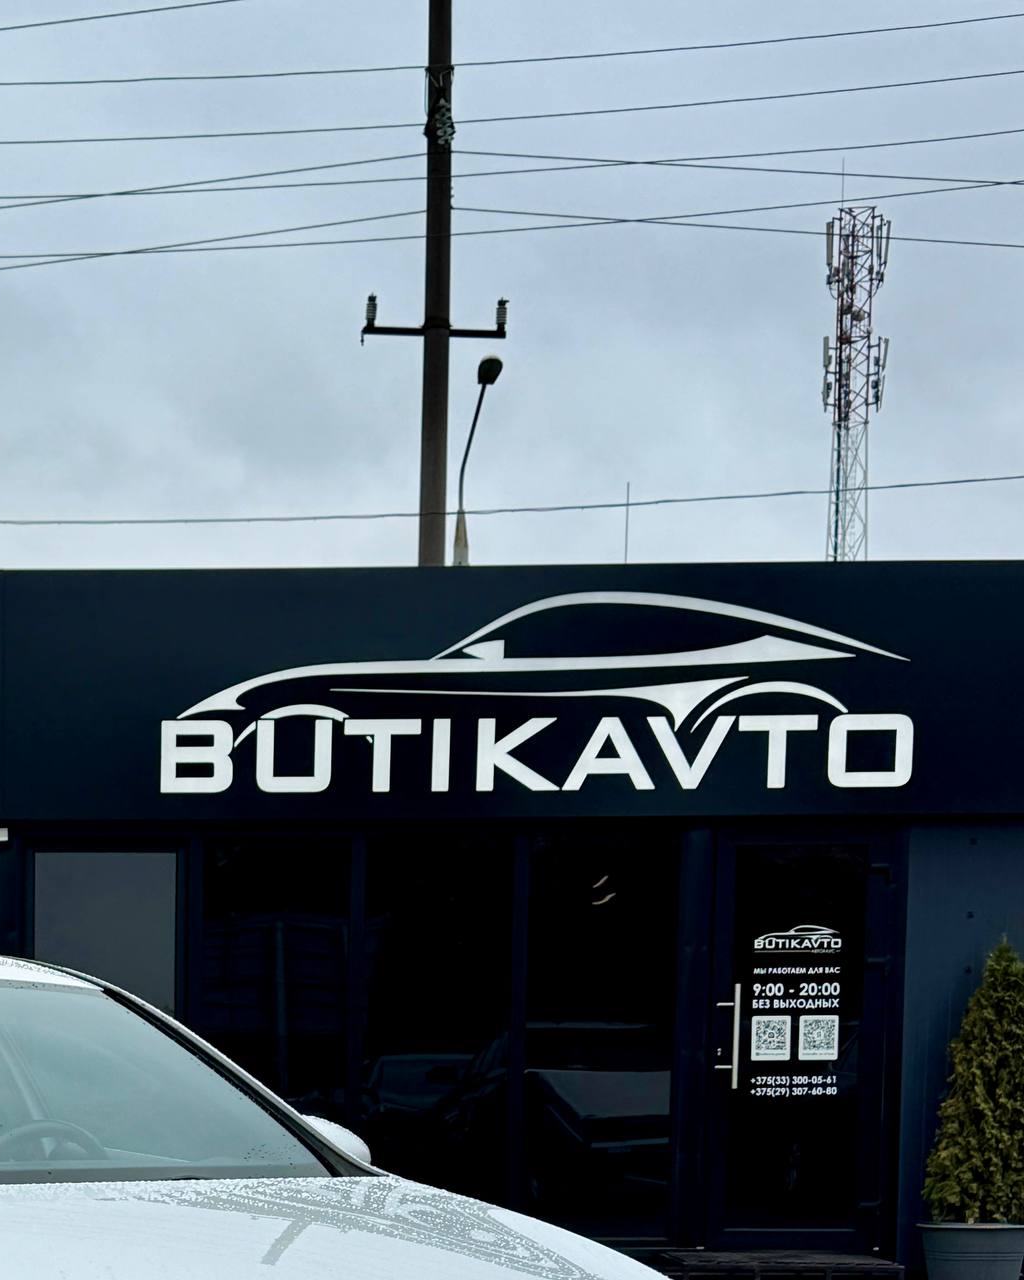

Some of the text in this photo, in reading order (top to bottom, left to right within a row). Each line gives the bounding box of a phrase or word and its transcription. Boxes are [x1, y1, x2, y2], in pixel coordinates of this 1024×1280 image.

[160, 714, 914, 793] BUTIKAVTO
[754, 938, 842, 949] BUTIKAVTO
[824, 966, 841, 974] ВАС
[752, 983, 784, 996] 9:00
[799, 982, 840, 996] 20:00
[752, 998, 840, 1009] БЕЗ ВЫХОДНЫХ
[750, 1075, 837, 1086] +375(33) 300-05-61
[750, 1087, 838, 1097] +375(29) 307-60-80
